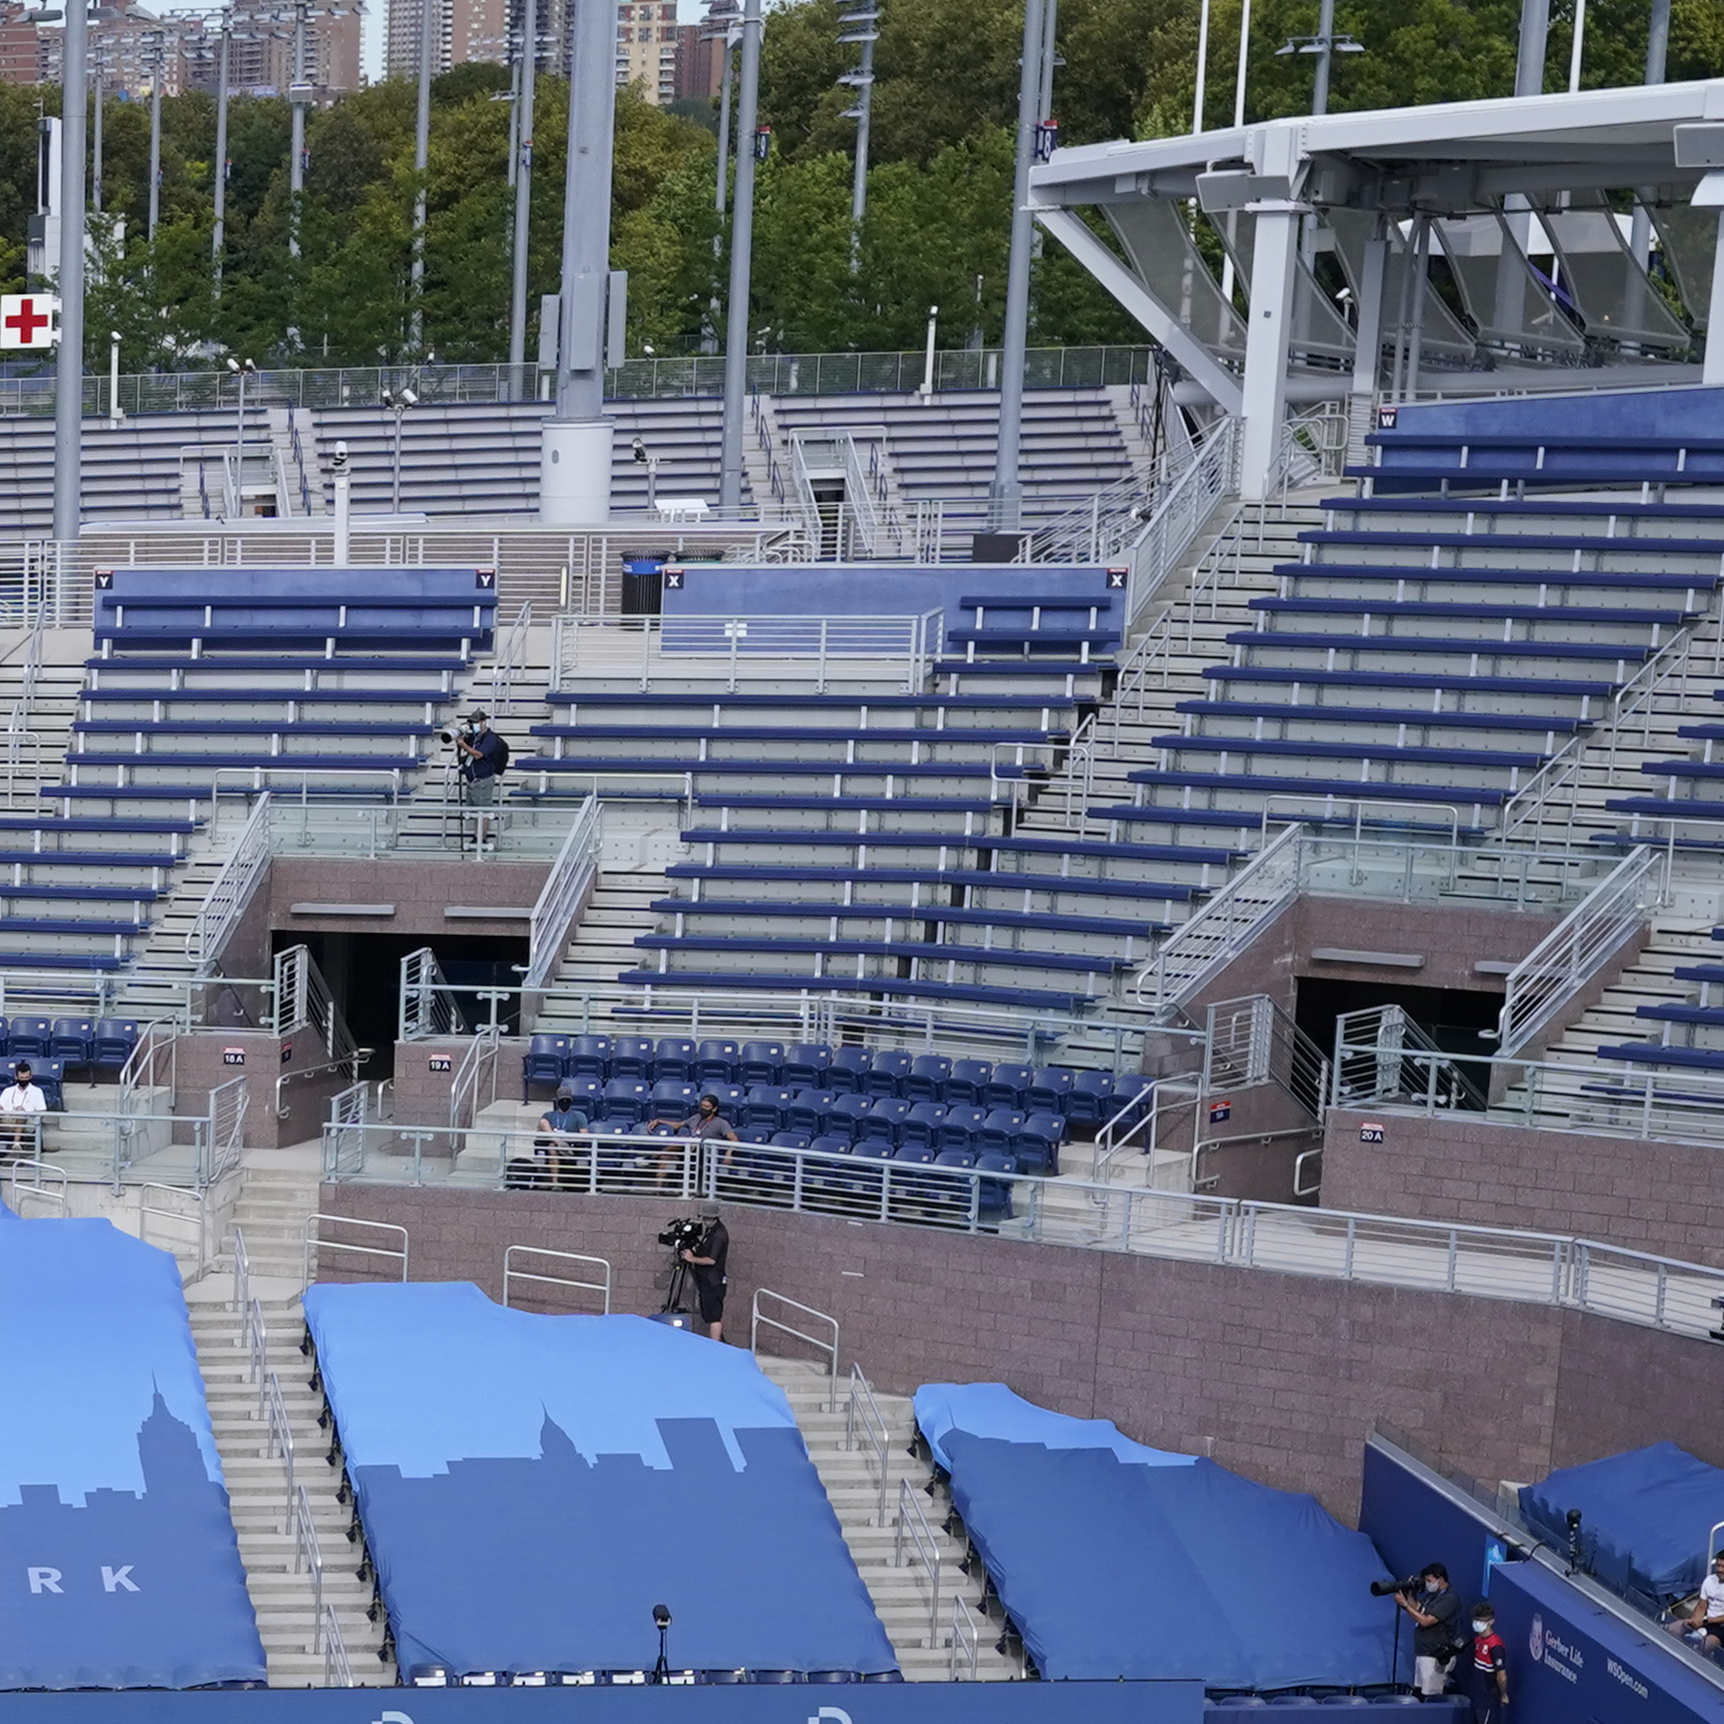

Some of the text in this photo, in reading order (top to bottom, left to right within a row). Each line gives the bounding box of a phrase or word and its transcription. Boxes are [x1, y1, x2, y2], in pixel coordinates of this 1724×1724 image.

[1381, 415, 1395, 427] W
[99, 576, 109, 588] Y
[480, 575, 490, 587] Y
[668, 575, 679, 587] X
[1111, 575, 1123, 587] X
[1545, 1629, 1584, 1669] Gerber Life
[1544, 1648, 1578, 1684] Insurance
[1607, 1657, 1649, 1700] WSOpen.com
